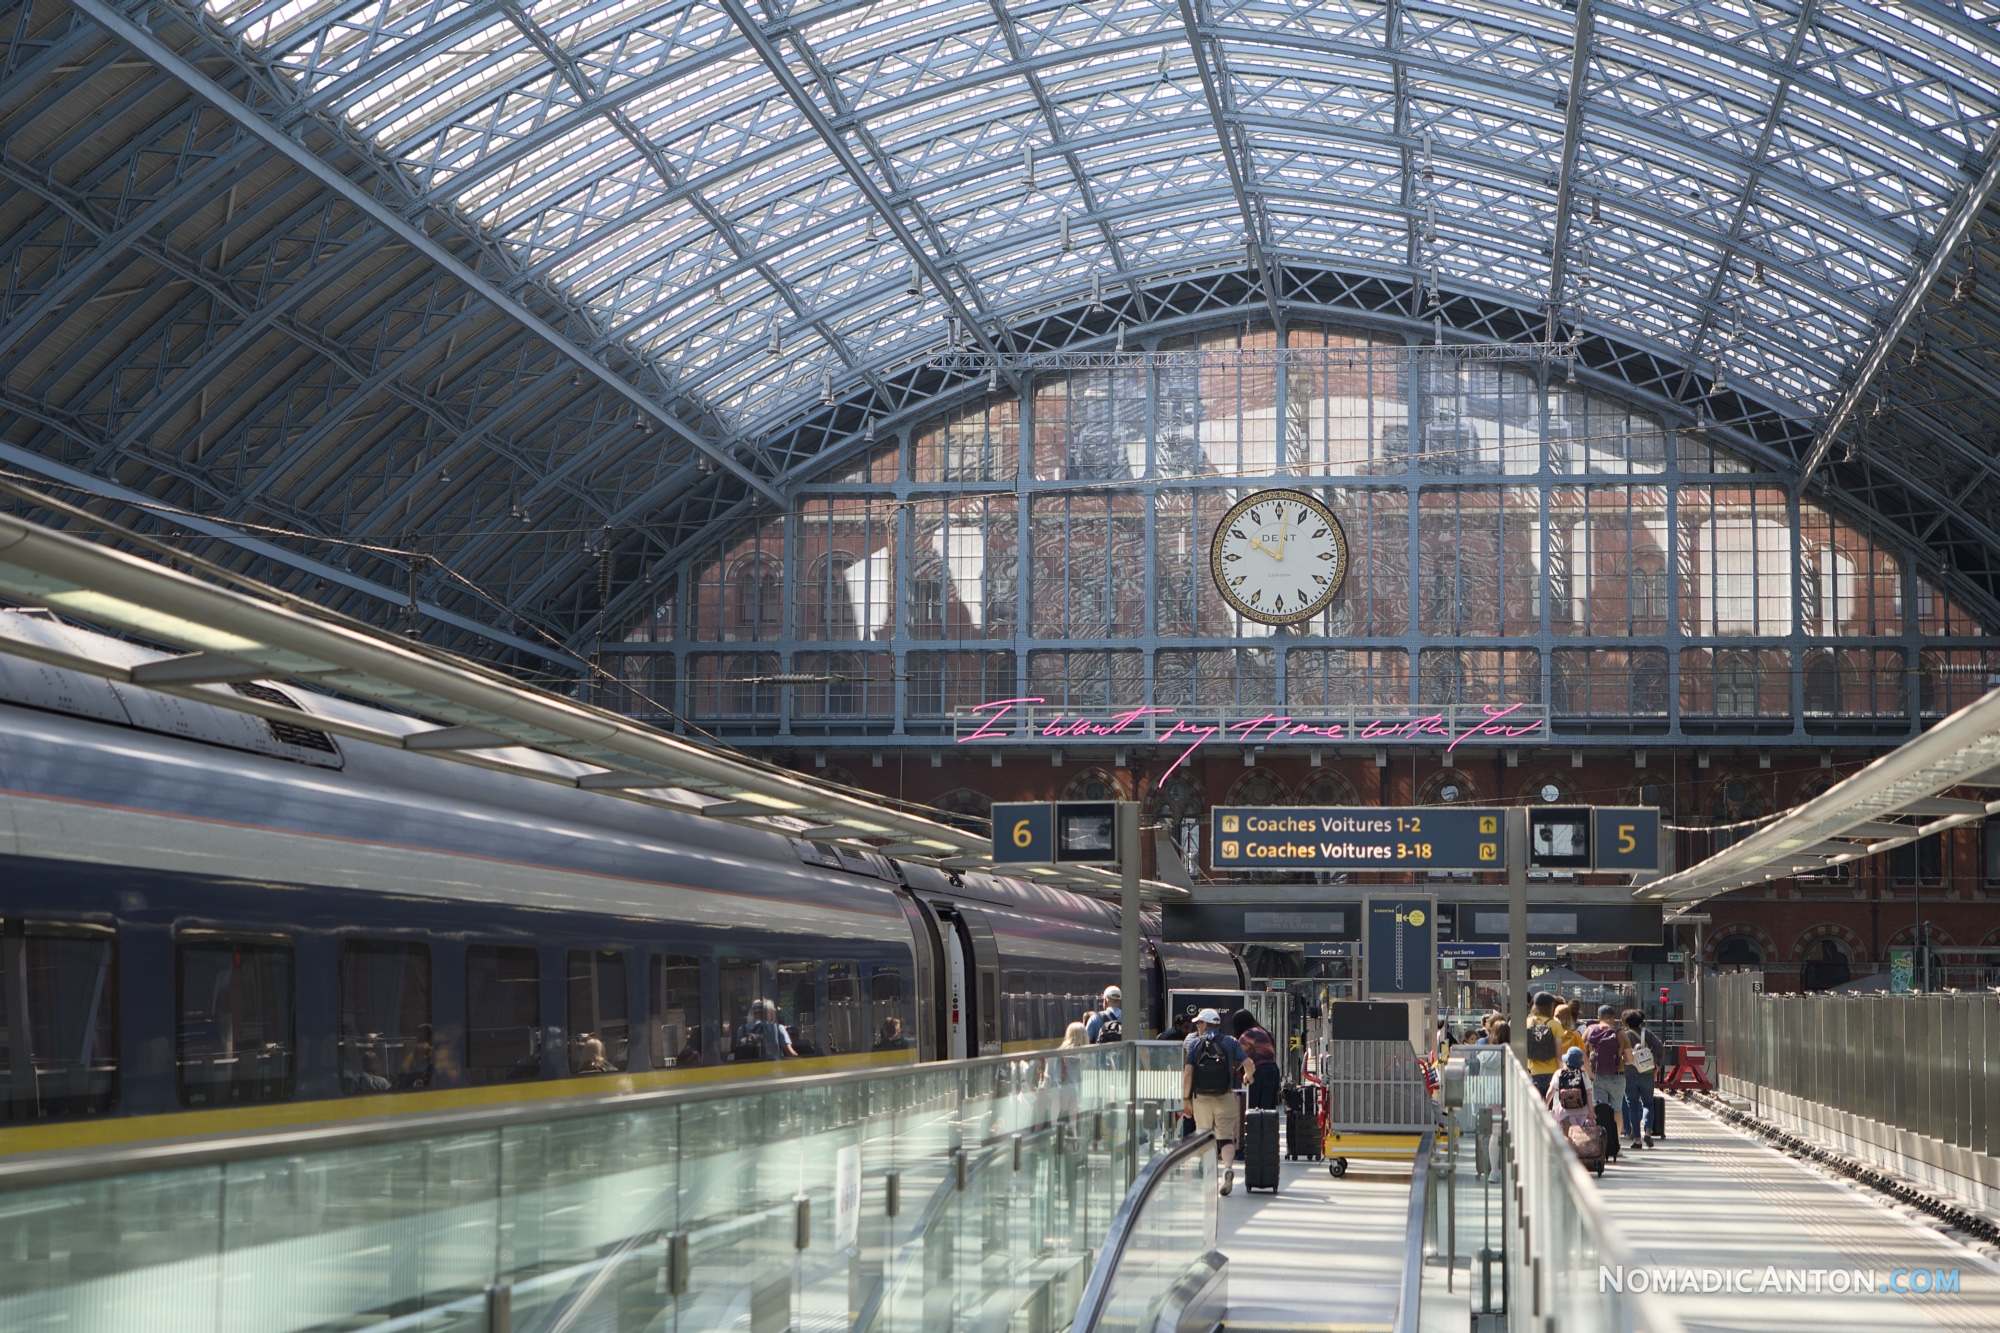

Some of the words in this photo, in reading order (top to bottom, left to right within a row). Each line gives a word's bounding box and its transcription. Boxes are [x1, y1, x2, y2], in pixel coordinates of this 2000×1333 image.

[1262, 533, 1297, 542] DENT
[957, 697, 1046, 743] I
[1042, 706, 1174, 736] want
[1158, 720, 1219, 788] my
[1361, 714, 1451, 739] with
[1013, 819, 1032, 848] 6
[1246, 816, 1316, 832] Coaches
[1321, 817, 1392, 832] Voitures
[1397, 817, 1421, 833] 1-2
[1246, 842, 1316, 858] Coaches
[1320, 842, 1392, 858] Voitures
[1396, 843, 1432, 859] 3-18
[1618, 824, 1636, 854] 5
